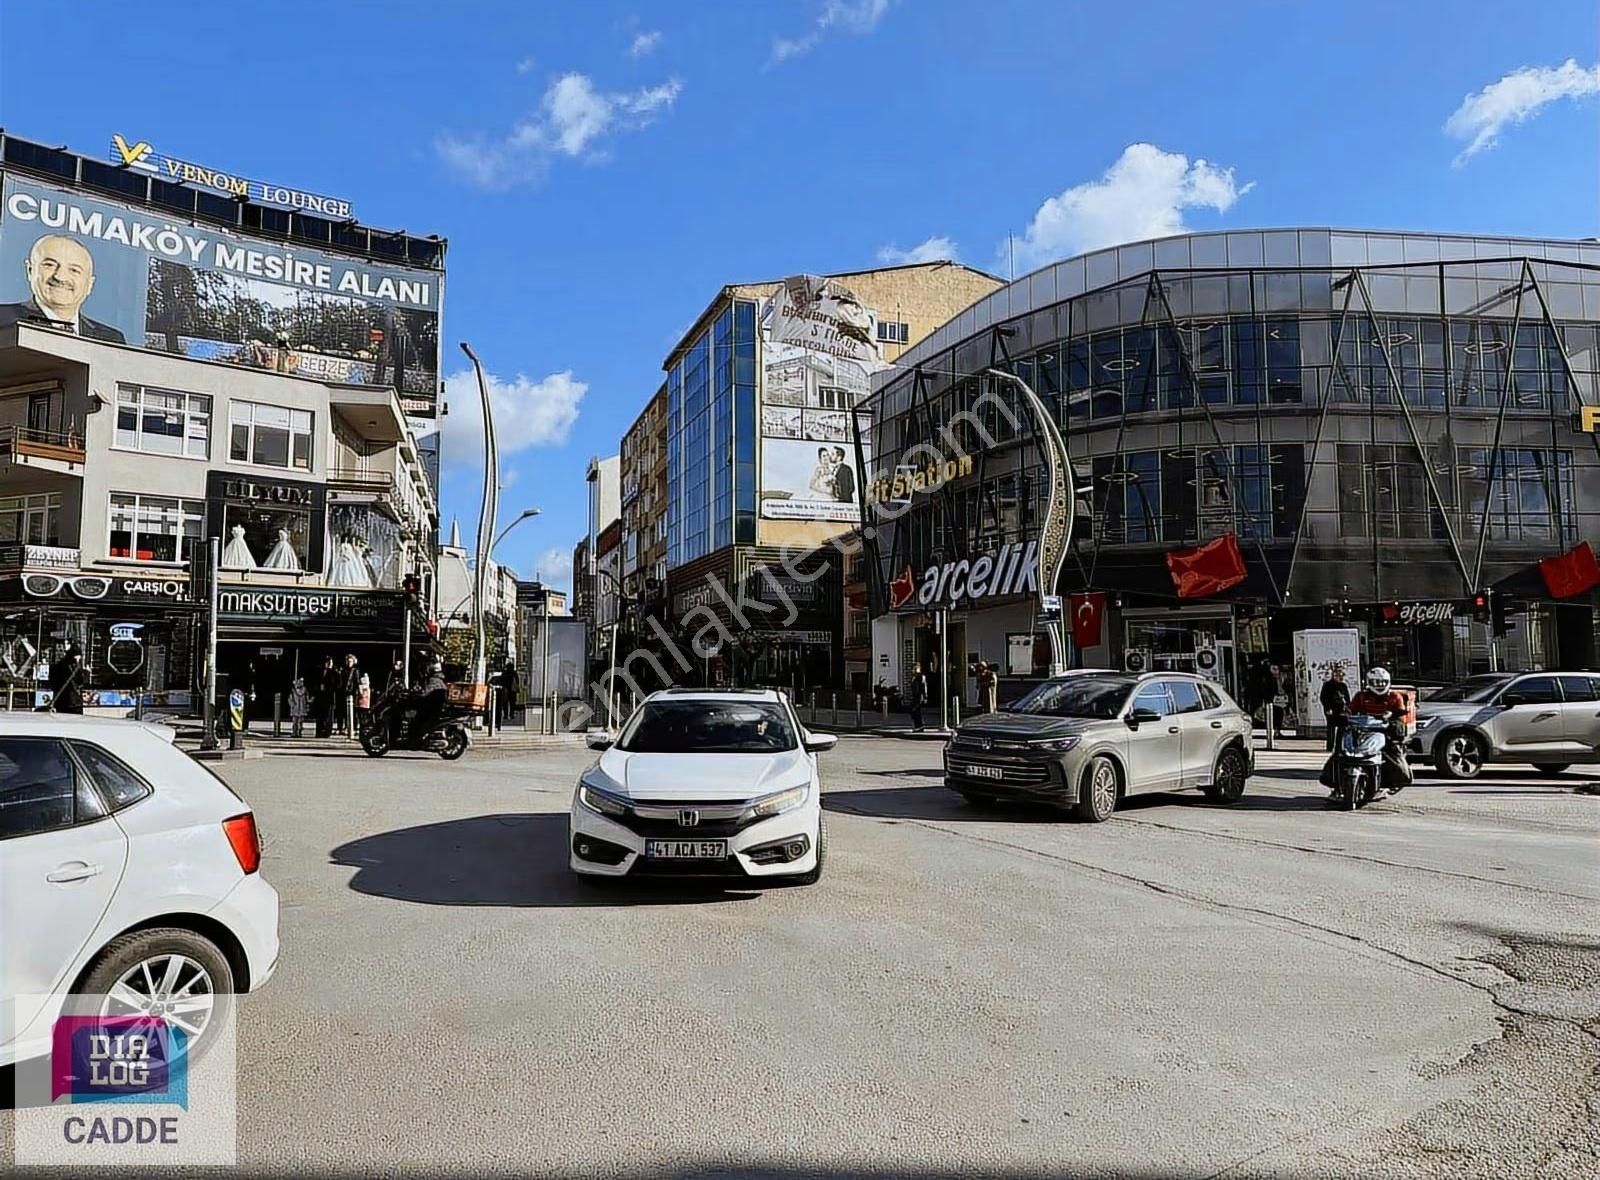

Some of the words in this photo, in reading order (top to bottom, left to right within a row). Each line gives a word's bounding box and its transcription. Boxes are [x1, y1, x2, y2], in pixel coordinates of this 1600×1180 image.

[165, 158, 249, 196] VENOM
[262, 185, 351, 218] LOUNGE
[8, 193, 208, 262] CUMAKÖY
[215, 242, 331, 290] MESİRE
[338, 270, 430, 305] ALANI
[300, 356, 348, 376] GEBZE
[919, 540, 1039, 611] arçelik
[1400, 603, 1455, 623] arçelik
[655, 843, 669, 857] 41
[675, 843, 696, 857] ACA
[701, 843, 723, 857] 537
